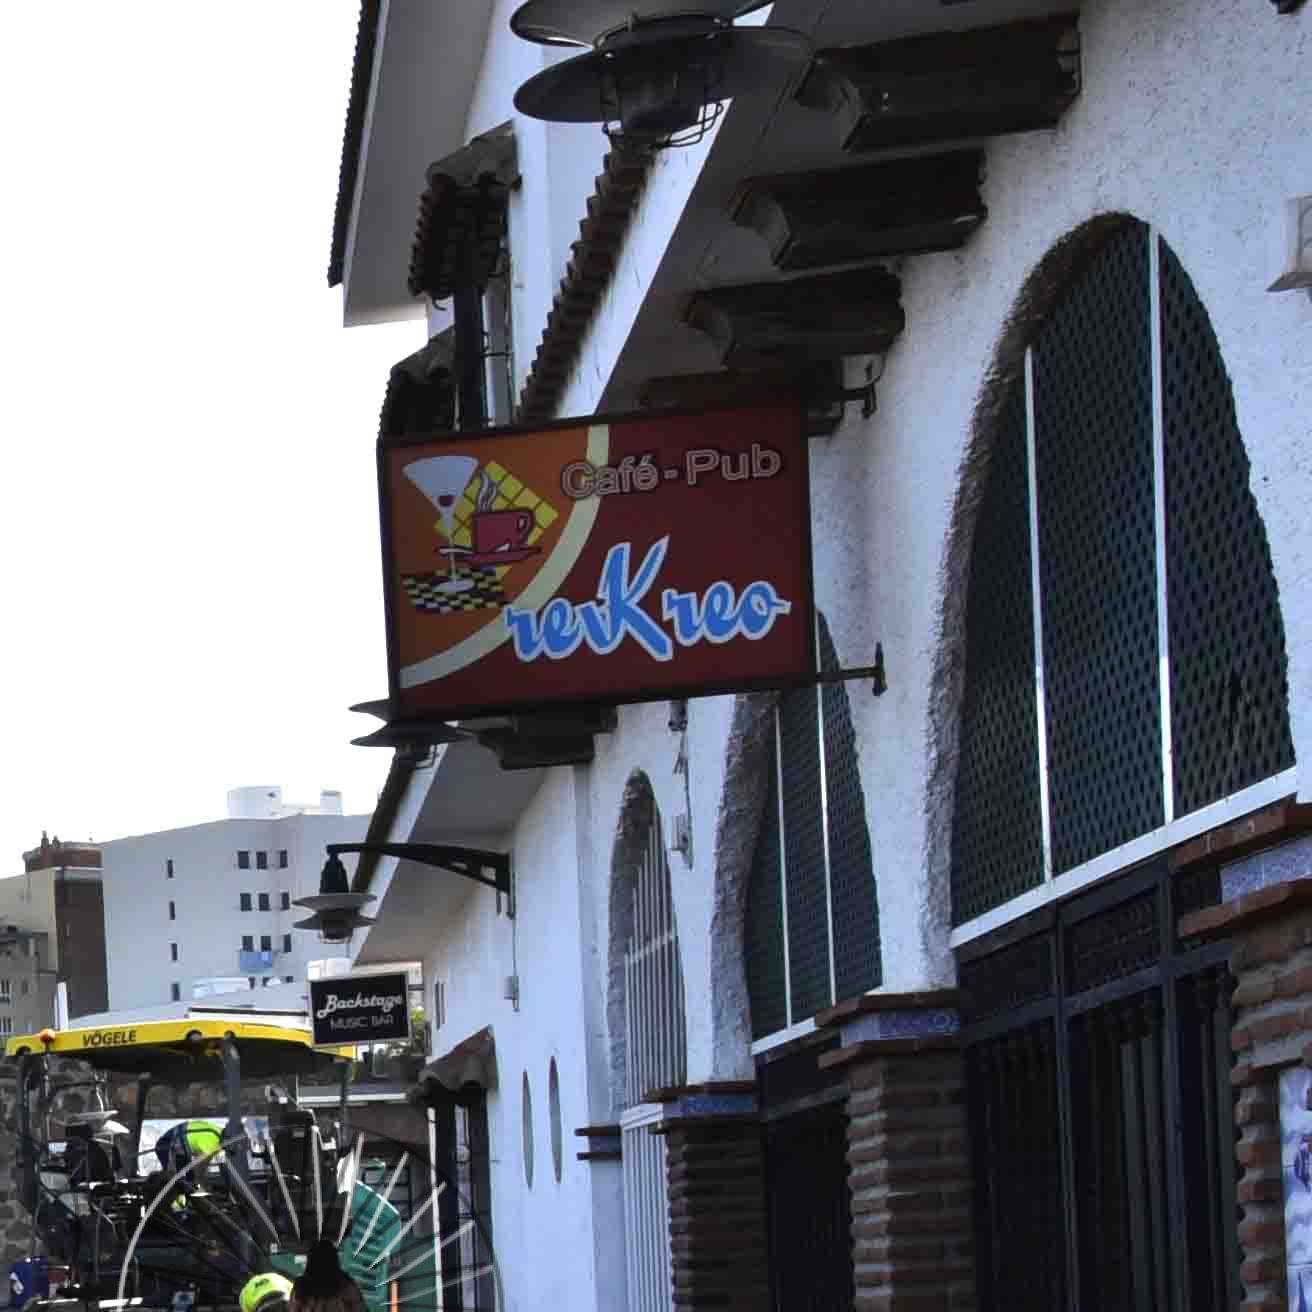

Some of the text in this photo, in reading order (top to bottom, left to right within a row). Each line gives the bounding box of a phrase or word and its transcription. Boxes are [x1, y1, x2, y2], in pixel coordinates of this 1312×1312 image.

[316, 993, 403, 1019] Backstage
[371, 1013, 394, 1026] BAR
[82, 1028, 137, 1047] VÖGELE
